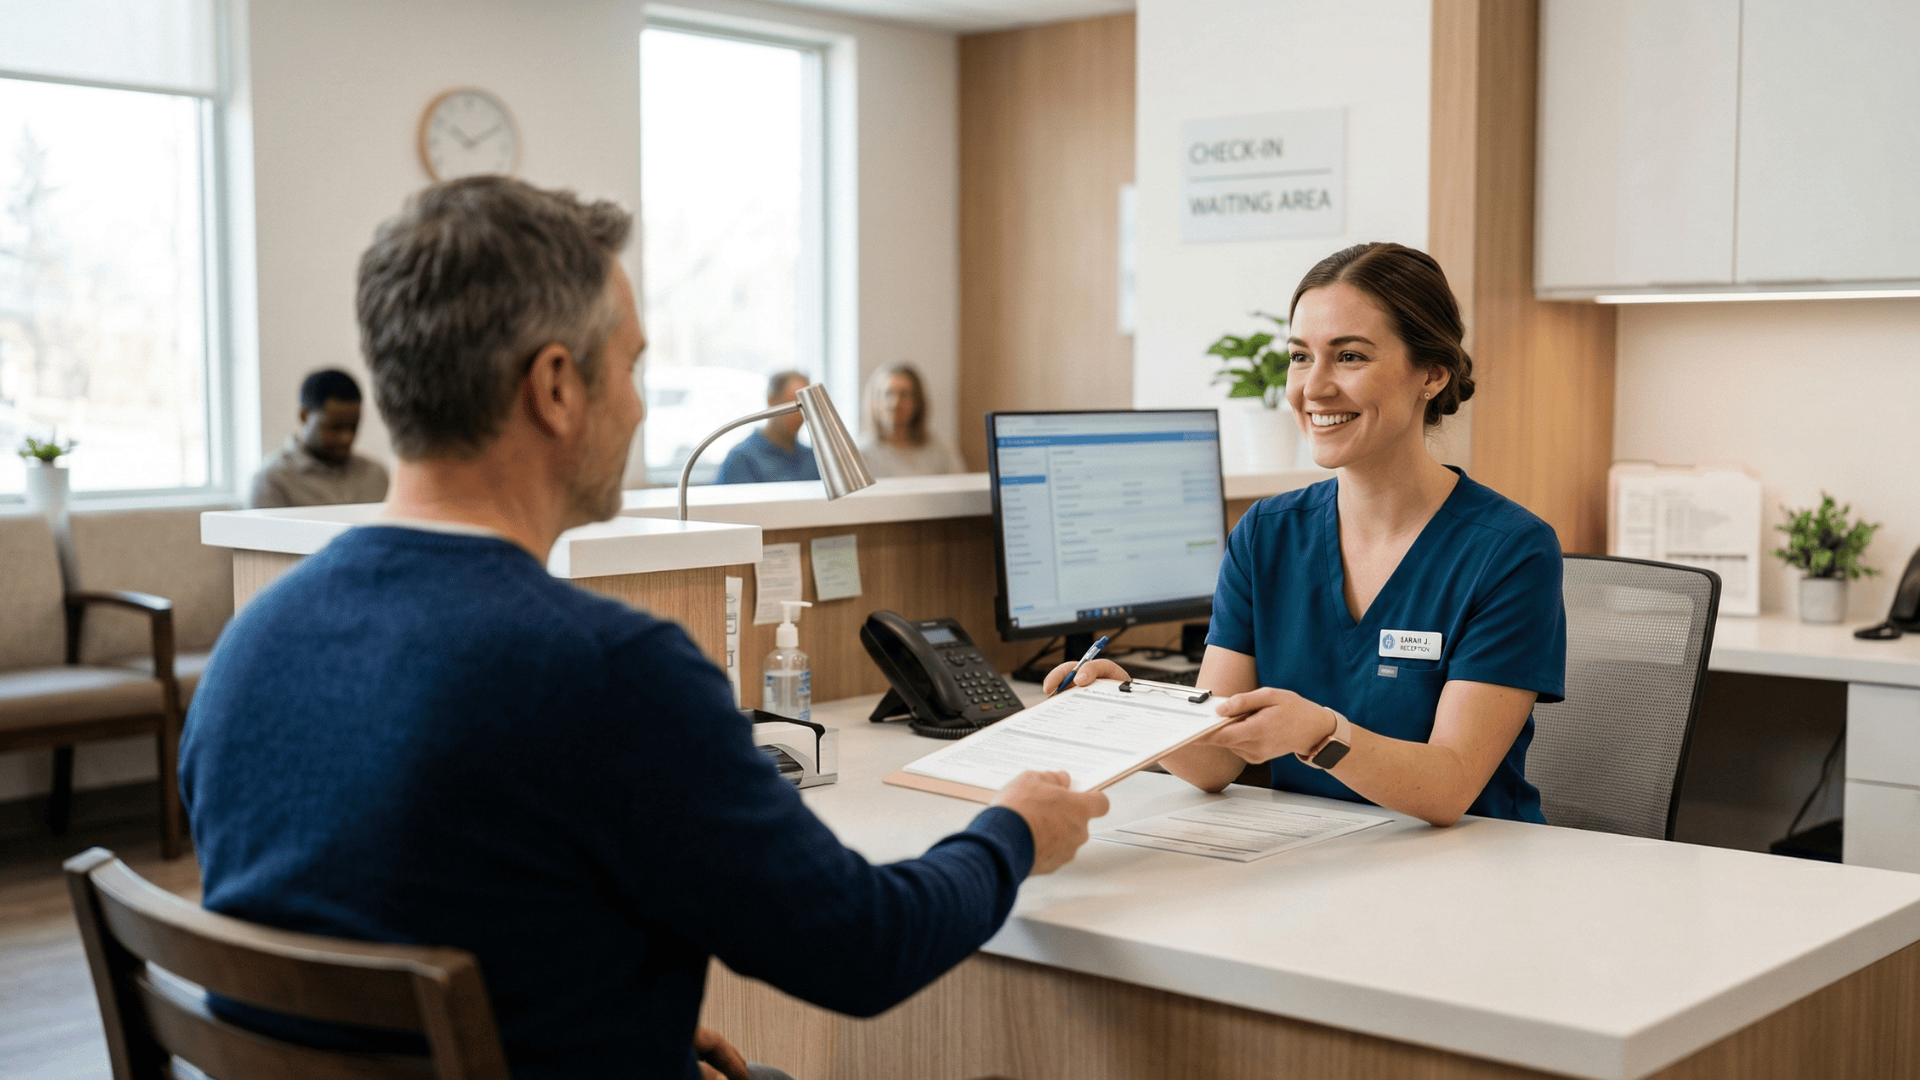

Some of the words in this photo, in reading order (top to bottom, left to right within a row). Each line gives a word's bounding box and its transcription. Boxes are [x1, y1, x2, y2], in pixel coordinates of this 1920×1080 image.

[1189, 138, 1284, 164] CHECK-IN
[1189, 191, 1273, 215] WAITING
[1278, 188, 1332, 211] AREA
[1400, 636, 1422, 644] SARAH
